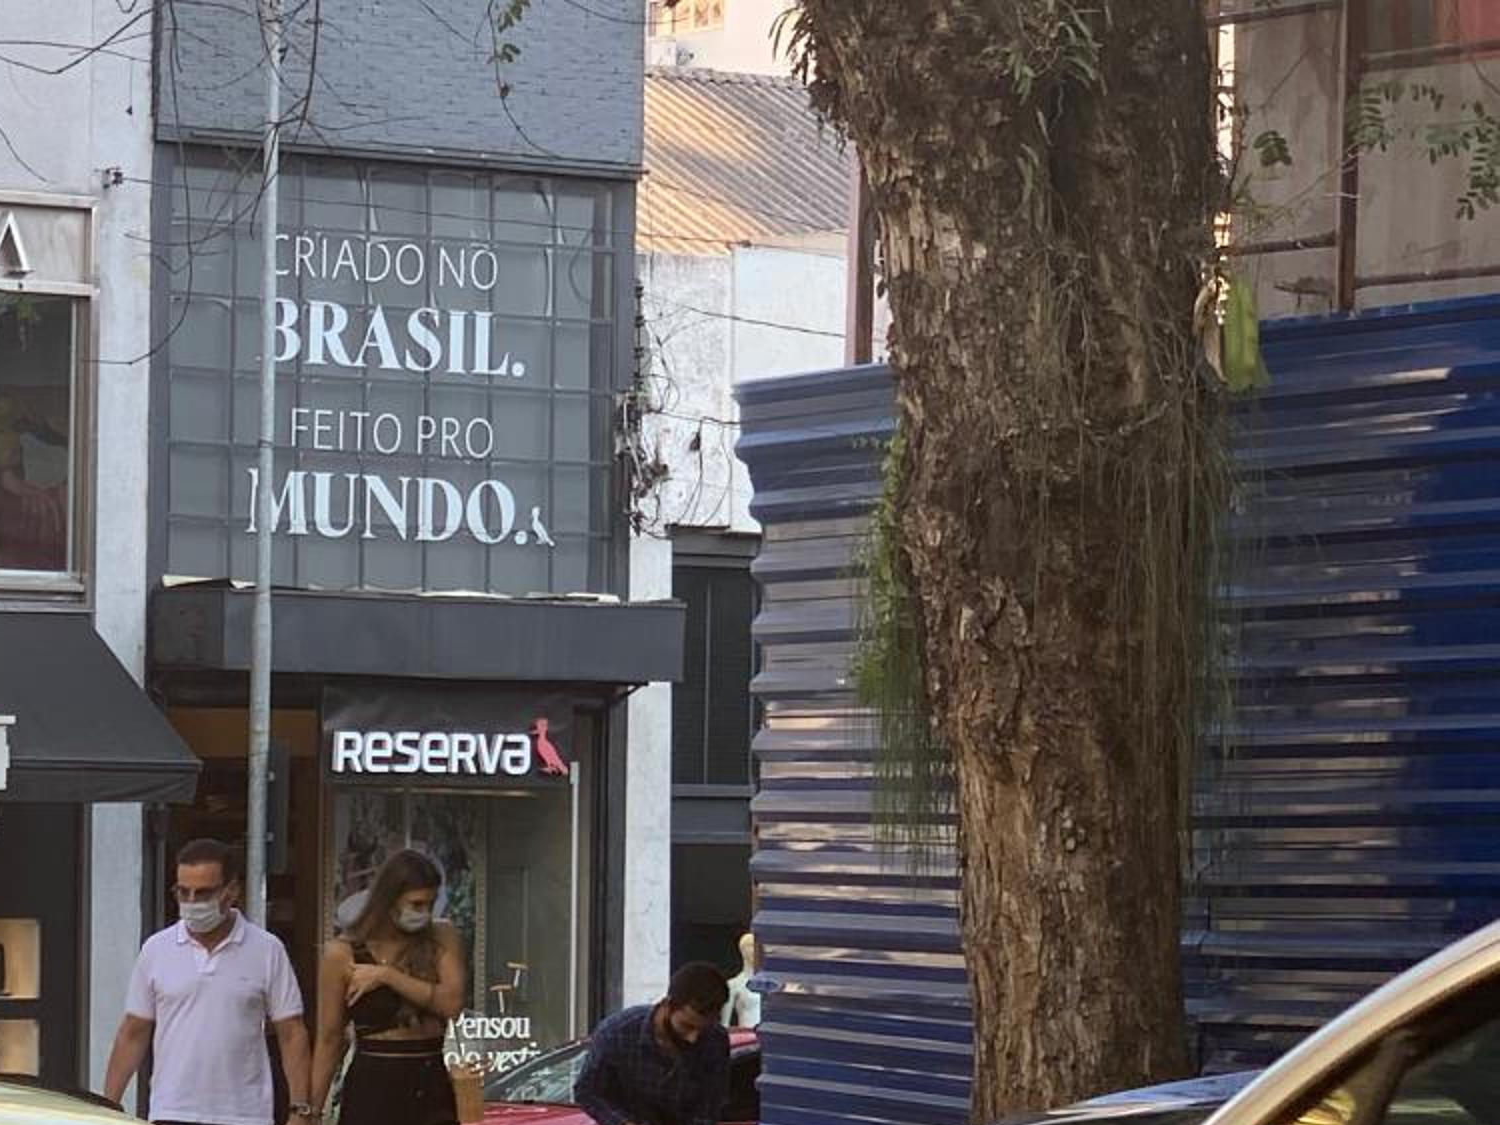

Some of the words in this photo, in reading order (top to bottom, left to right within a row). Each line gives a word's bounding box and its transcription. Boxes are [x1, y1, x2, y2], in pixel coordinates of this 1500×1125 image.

[274, 233, 424, 285] CRIADO
[438, 246, 498, 290] NO
[257, 296, 526, 378] BRASIL.
[291, 407, 402, 454] FEITO
[417, 415, 495, 459] PRO
[245, 467, 528, 545] MUNDO.
